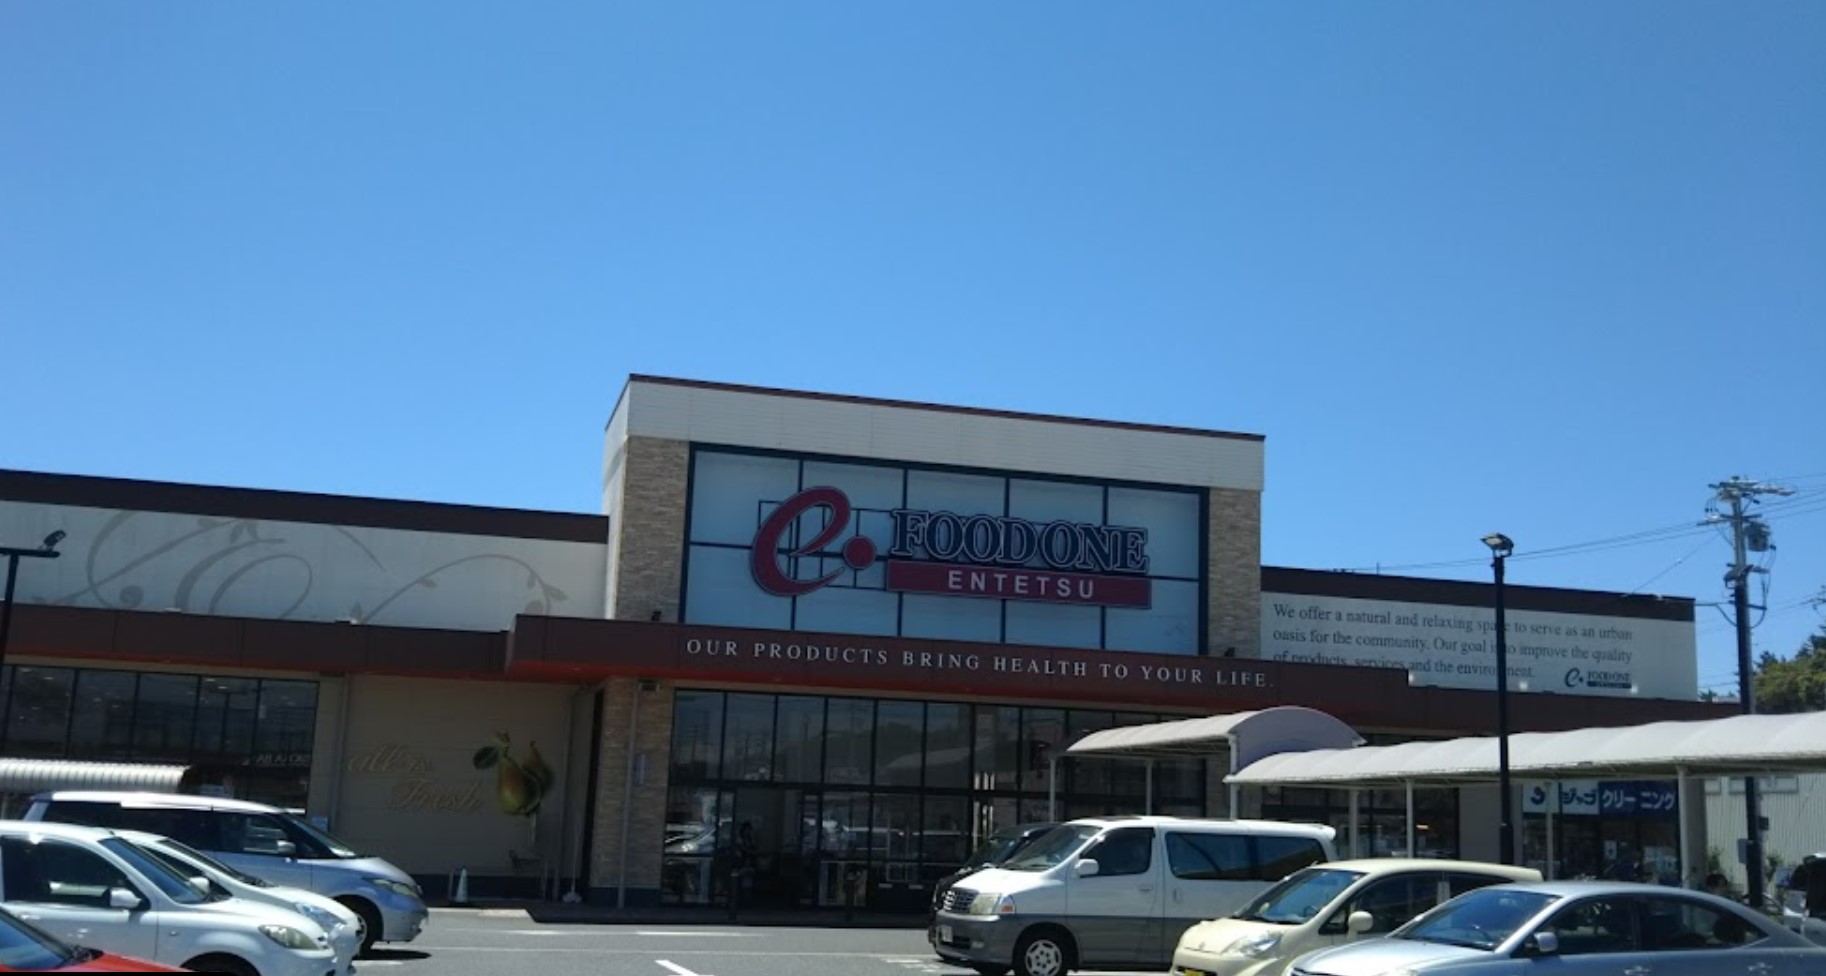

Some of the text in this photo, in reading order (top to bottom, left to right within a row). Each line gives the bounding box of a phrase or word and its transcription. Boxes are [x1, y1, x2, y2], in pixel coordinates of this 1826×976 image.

[948, 569, 1096, 599] ENTETSU
[1273, 603, 1633, 640] We offer a natural and relaxing spae to serve as an urban
[687, 639, 1274, 687] OUR PRODUCTS BRING HEALTH TO YOUR LIFE.
[1273, 628, 1306, 642] oasis
[1310, 629, 1330, 644] for
[1333, 630, 1352, 644] the
[1355, 632, 1429, 652] community.
[1433, 637, 1457, 651] Our
[1461, 640, 1487, 655] goal
[1519, 644, 1568, 659] improve
[1571, 646, 1589, 659] the
[1592, 647, 1633, 664] quality
[1408, 659, 1431, 672] and
[1435, 659, 1454, 673] the
[1457, 662, 1536, 679] enviroment.
